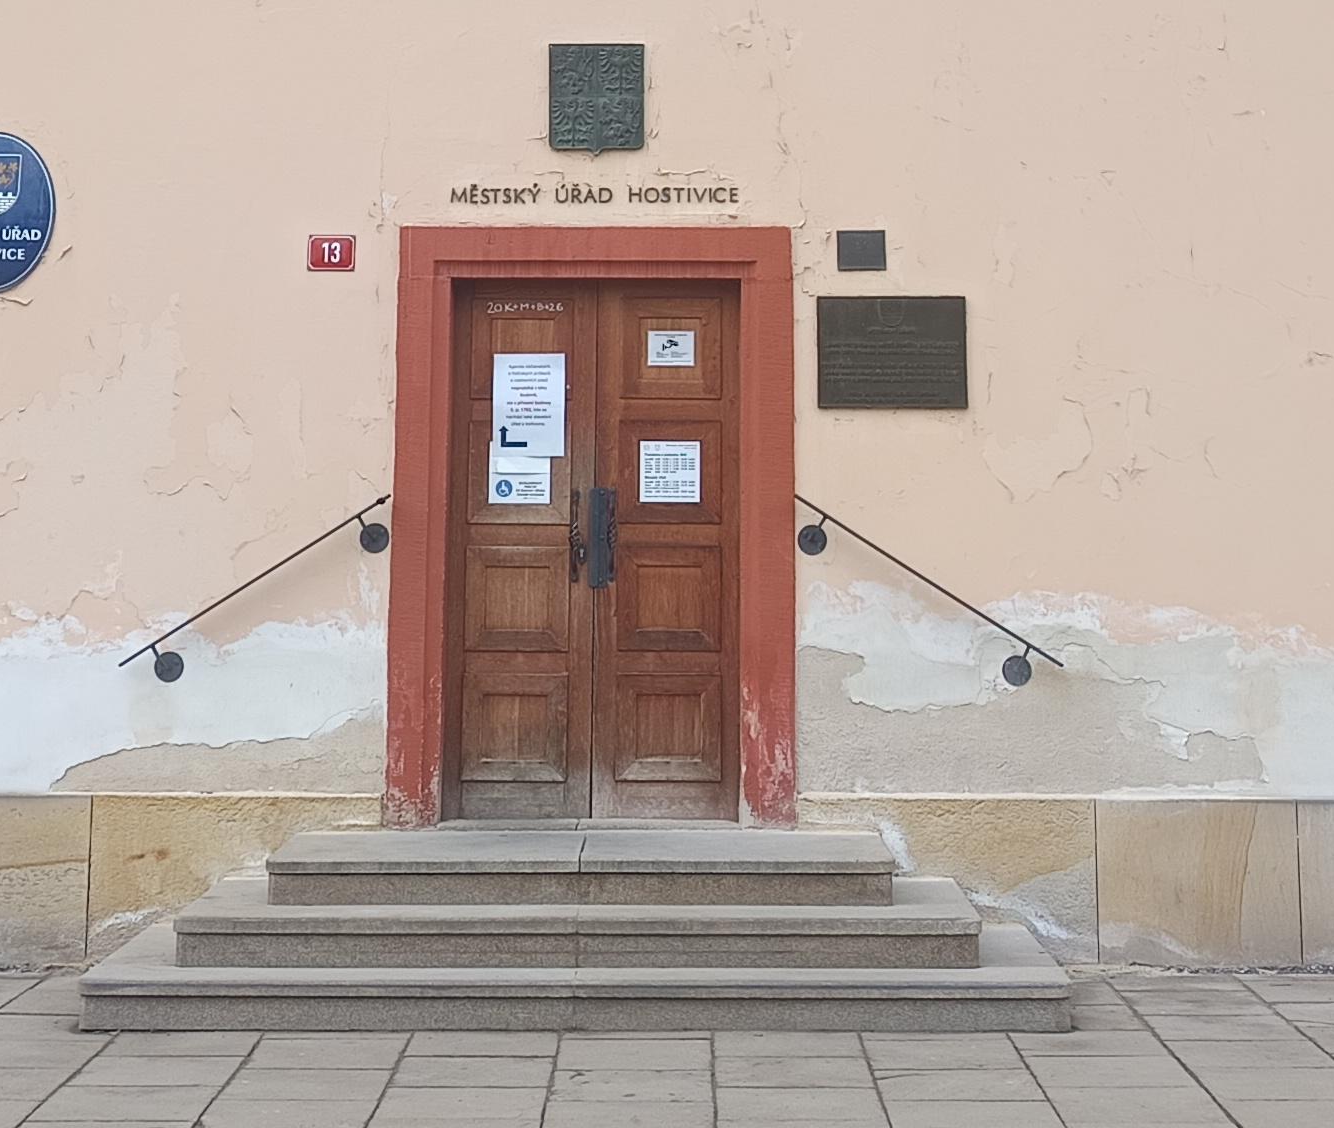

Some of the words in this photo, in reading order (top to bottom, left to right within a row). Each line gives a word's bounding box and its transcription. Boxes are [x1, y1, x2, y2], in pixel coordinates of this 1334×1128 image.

[450, 183, 541, 204] MĚSTSKÝ
[555, 183, 613, 204] ÚŘAD
[628, 186, 740, 204] HOSTIVICE
[2, 225, 42, 241] ÚŘAD
[322, 242, 340, 263] 13
